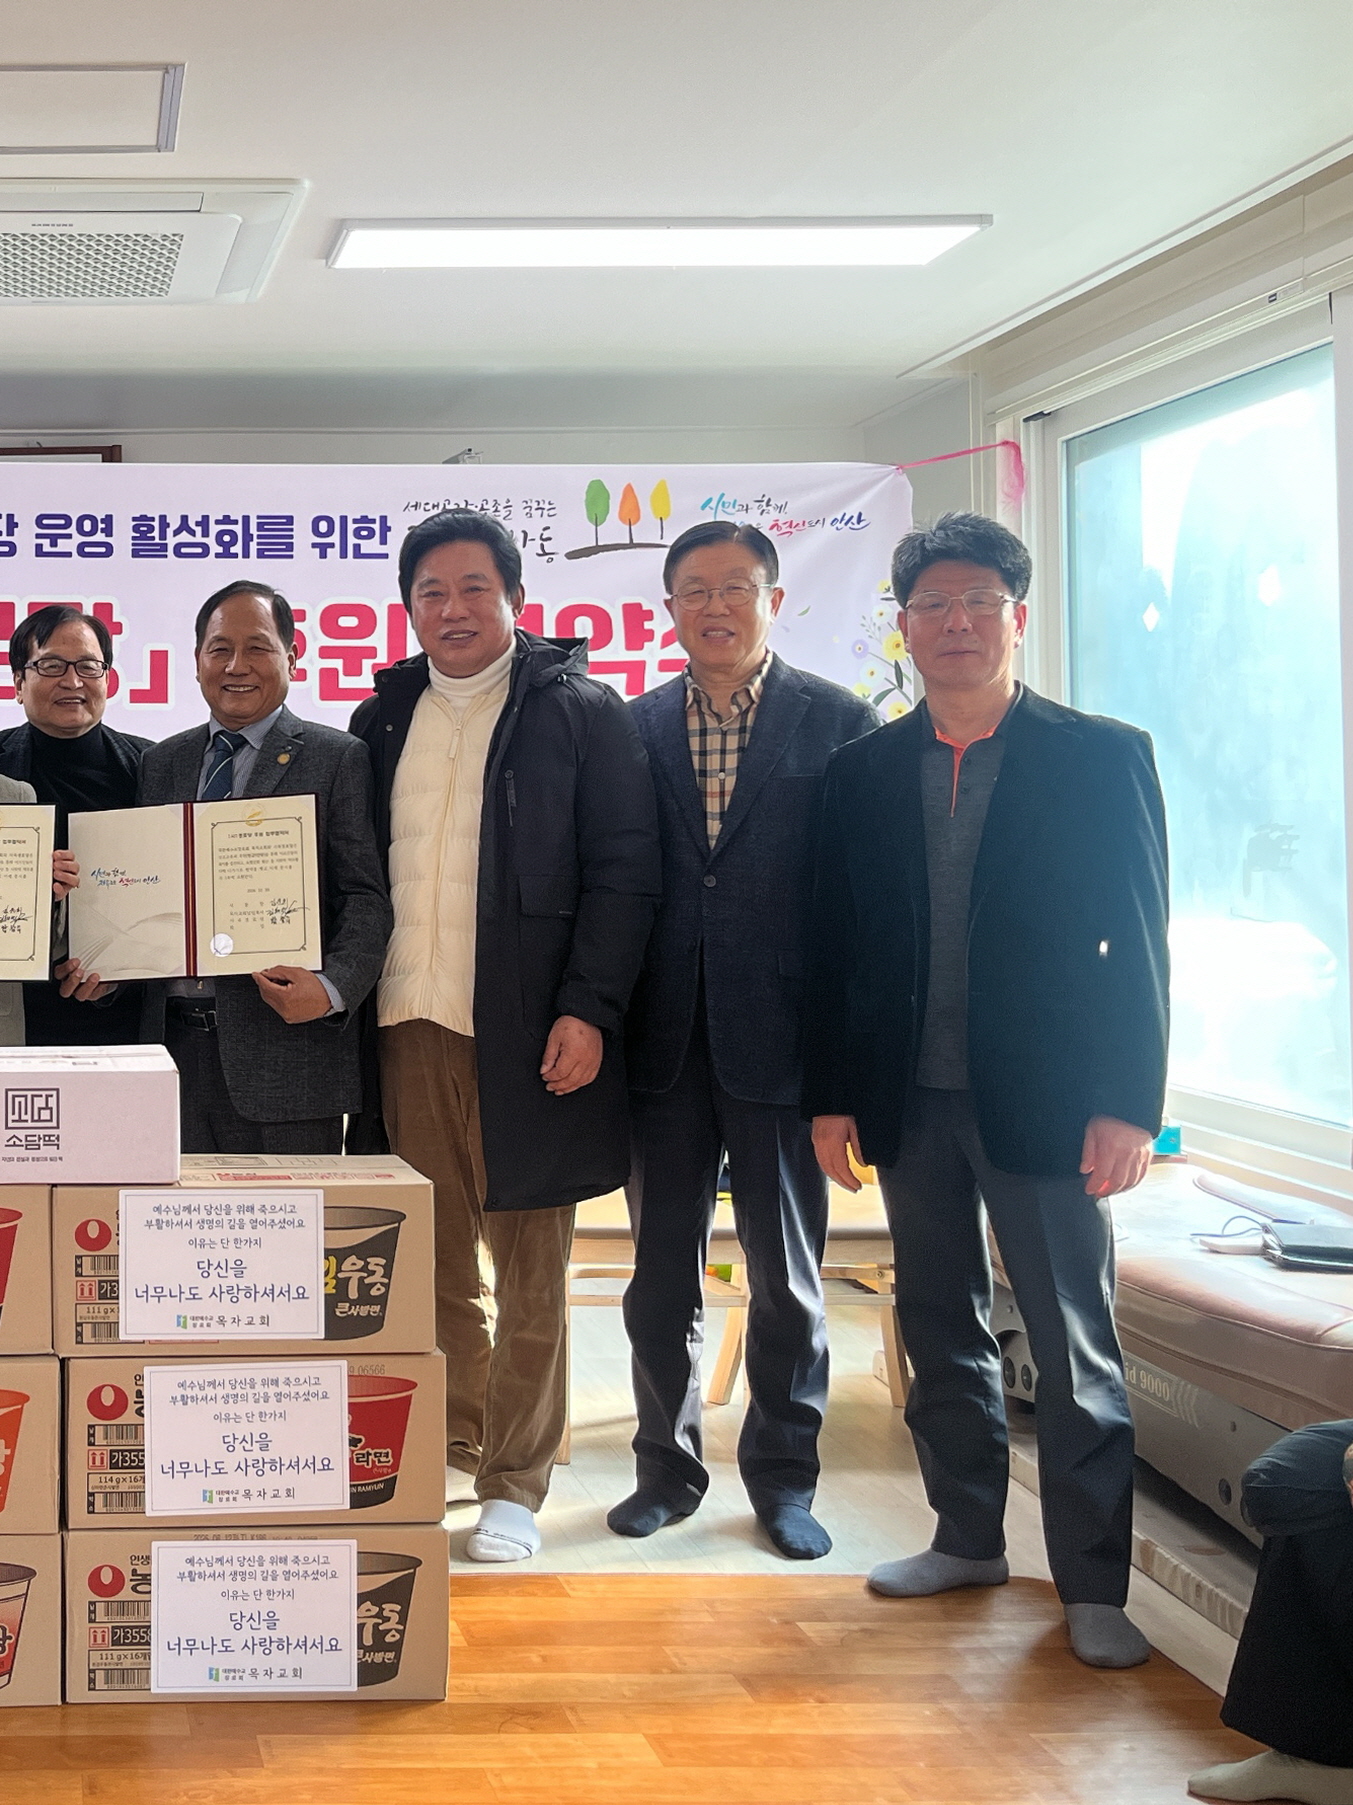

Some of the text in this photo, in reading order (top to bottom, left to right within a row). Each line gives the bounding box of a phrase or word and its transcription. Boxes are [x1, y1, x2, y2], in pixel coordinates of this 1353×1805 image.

[830, 512, 871, 531] 안산
[34, 513, 114, 558] 운영
[131, 514, 294, 560] 활성화를
[312, 514, 392, 560] 위한
[5, 1134, 59, 1150] 소담떡
[196, 1257, 247, 1278] 당신을
[134, 1282, 309, 1303] 너무나도 사랑하셔서요
[1140, 1370, 1169, 1401] 9000
[221, 1431, 272, 1453] 당신을
[111, 1452, 145, 1467] 가355
[160, 1453, 334, 1479] 너무나도 사랑하셔서요
[130, 1555, 151, 1566] 인생
[229, 1609, 280, 1630] 당신을
[167, 1634, 342, 1656] 너무나도 사랑하셔서요
